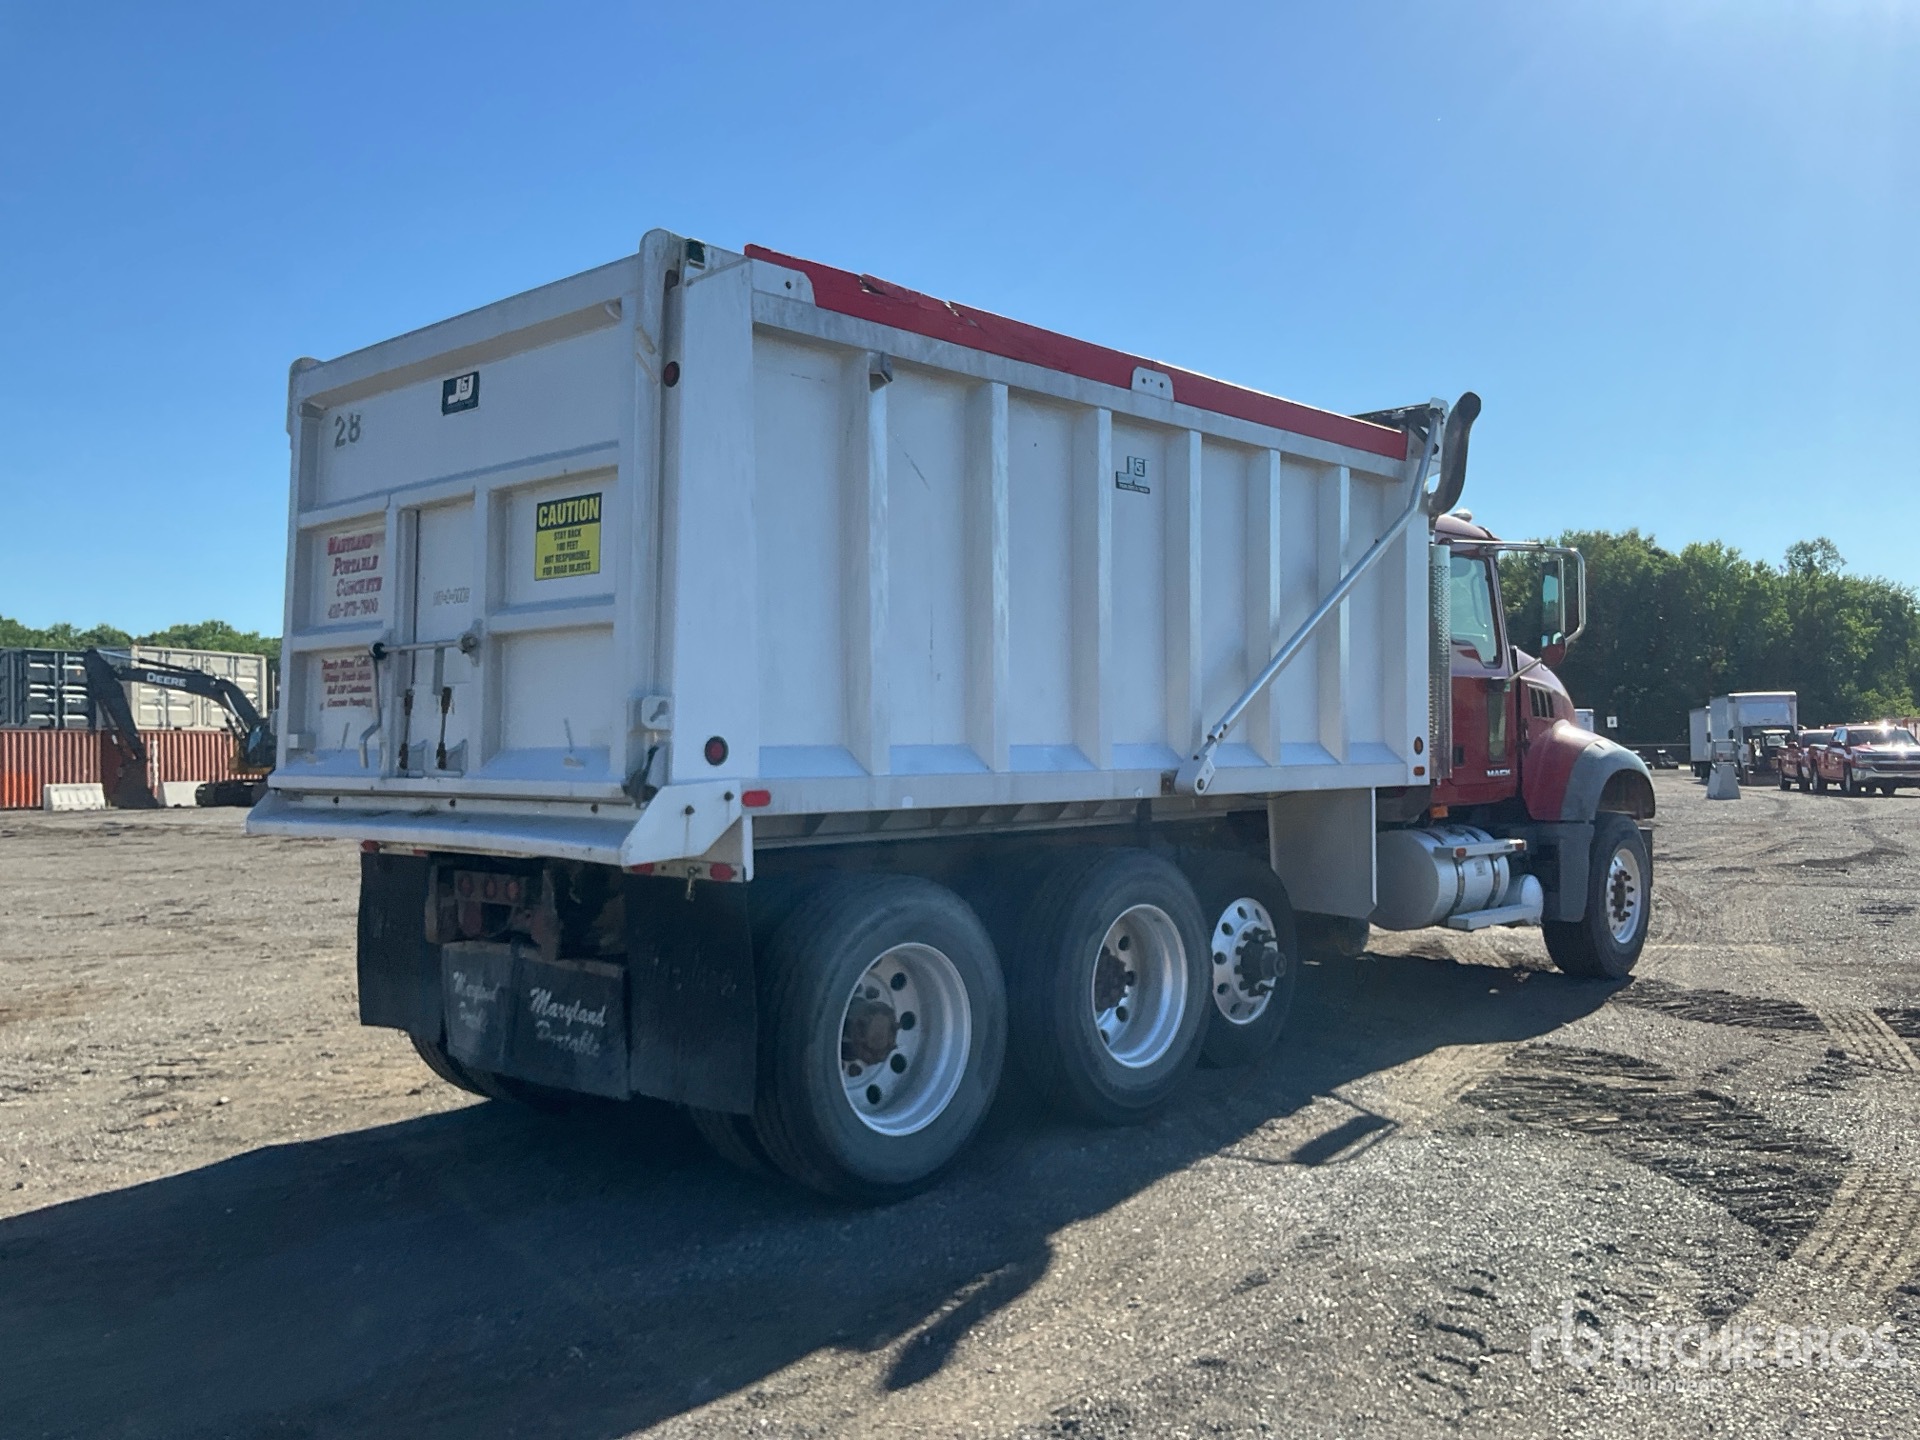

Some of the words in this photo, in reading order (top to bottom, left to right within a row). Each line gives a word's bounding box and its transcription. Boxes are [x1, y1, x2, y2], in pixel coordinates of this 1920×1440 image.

[335, 412, 361, 448] 28
[538, 496, 600, 528] CAUTION
[567, 527, 582, 539] BACK
[566, 540, 579, 550] FEET
[544, 554, 554, 565] NOT
[555, 549, 590, 563] RESPONSIBLE
[146, 671, 187, 688] DEERE
[1486, 768, 1511, 778] MACK
[530, 986, 606, 1028] Maryland
